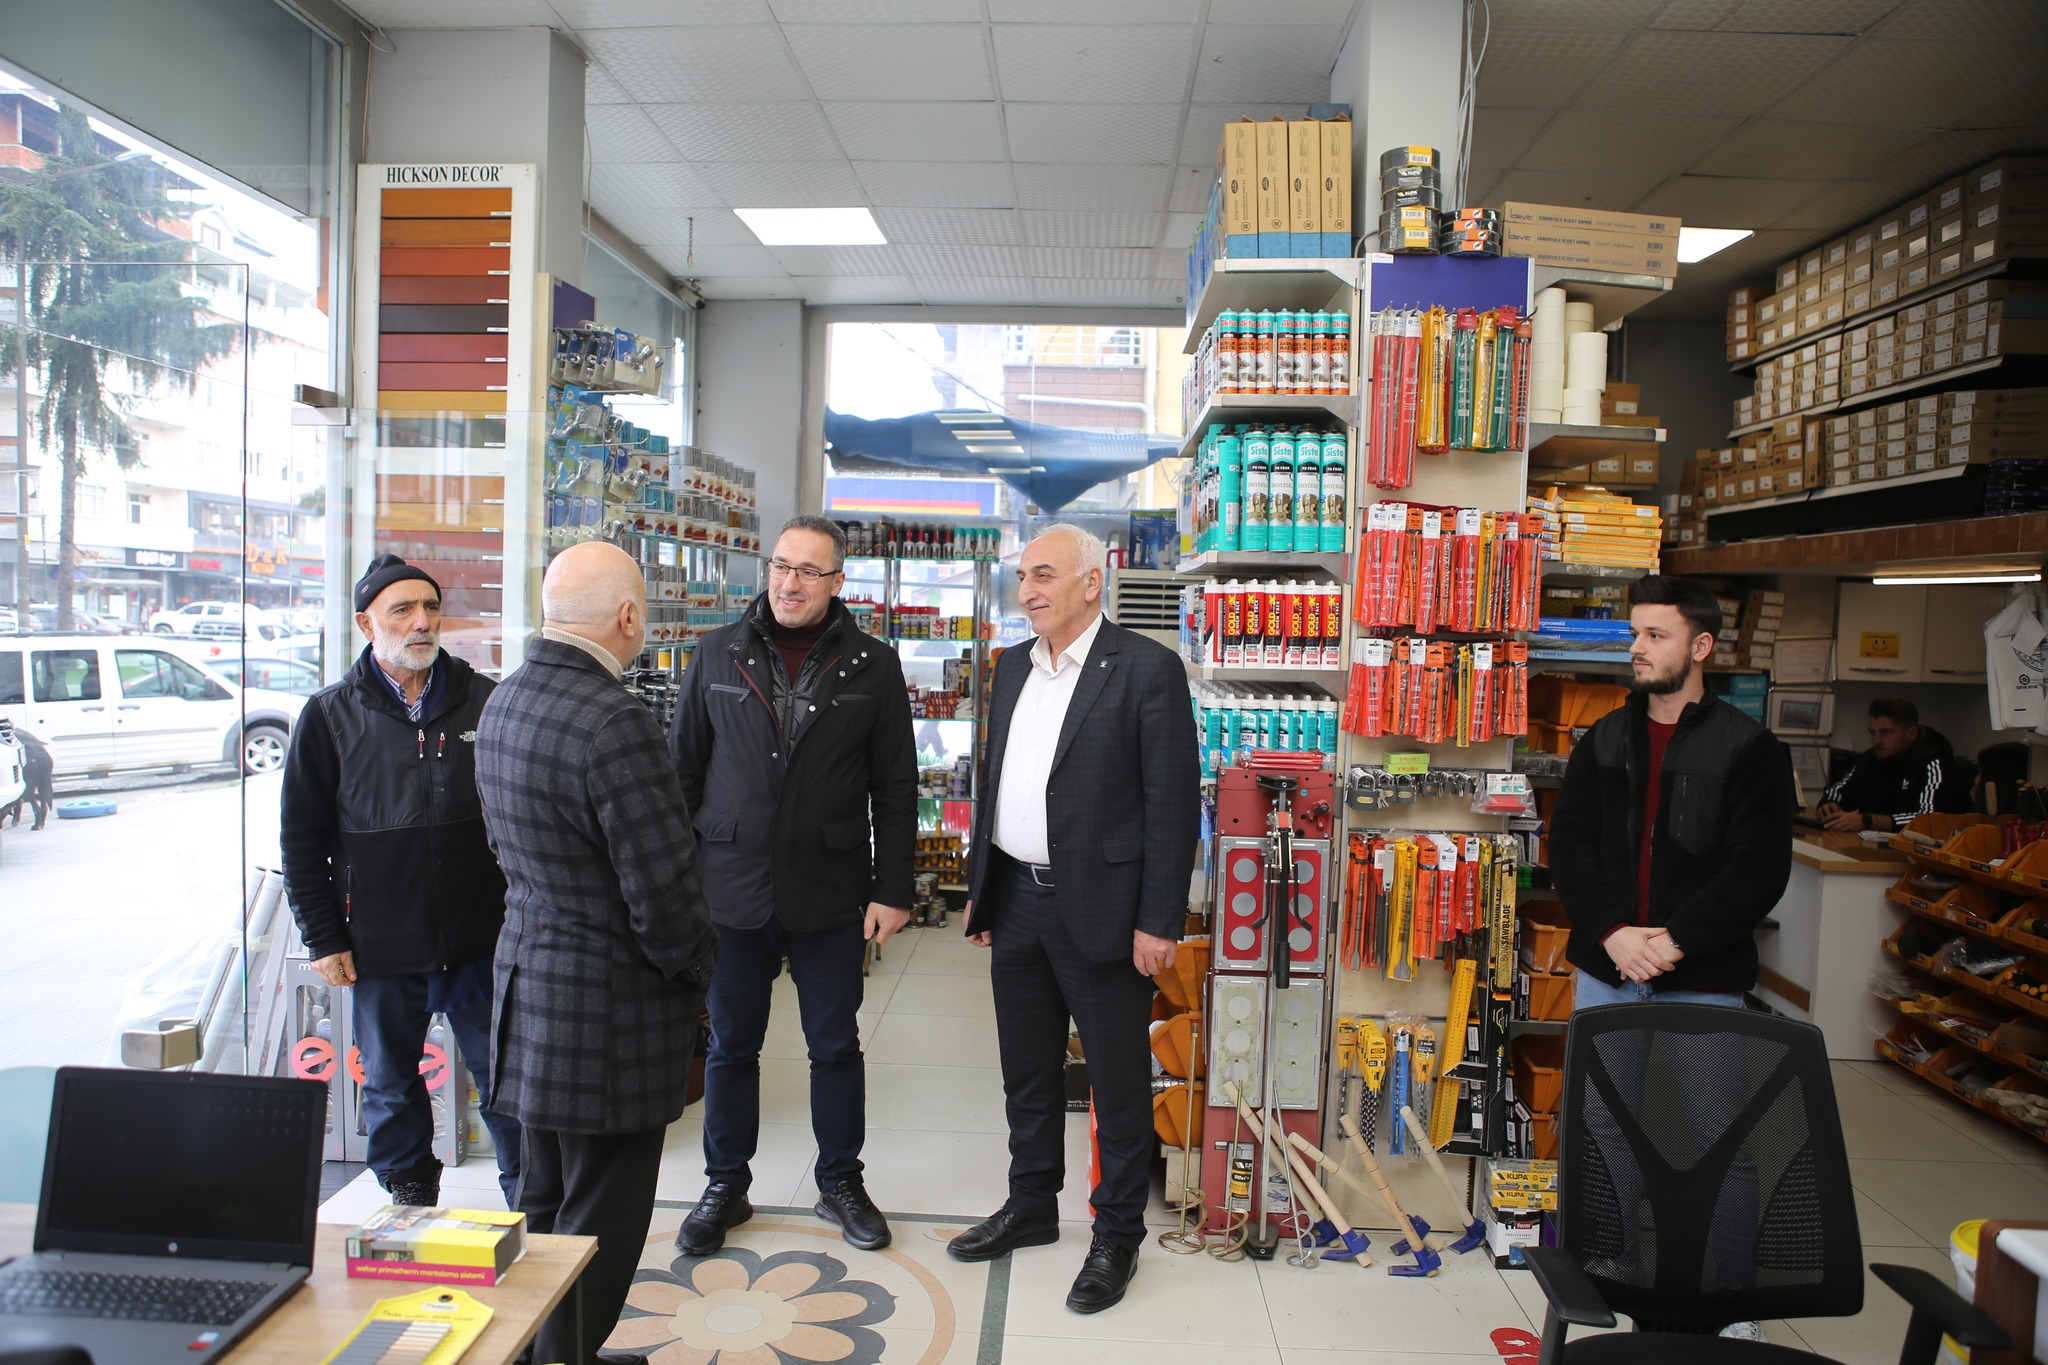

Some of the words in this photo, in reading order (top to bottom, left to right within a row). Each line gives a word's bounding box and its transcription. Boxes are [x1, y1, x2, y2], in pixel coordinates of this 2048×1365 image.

[386, 166, 449, 183] HICKSON
[452, 165, 500, 182] DECOR
[1273, 446, 1292, 455] Sista
[1300, 446, 1319, 456] Sista
[1326, 447, 1344, 457] Sista
[356, 1265, 378, 1273] weber
[460, 1270, 486, 1280] sistemi
